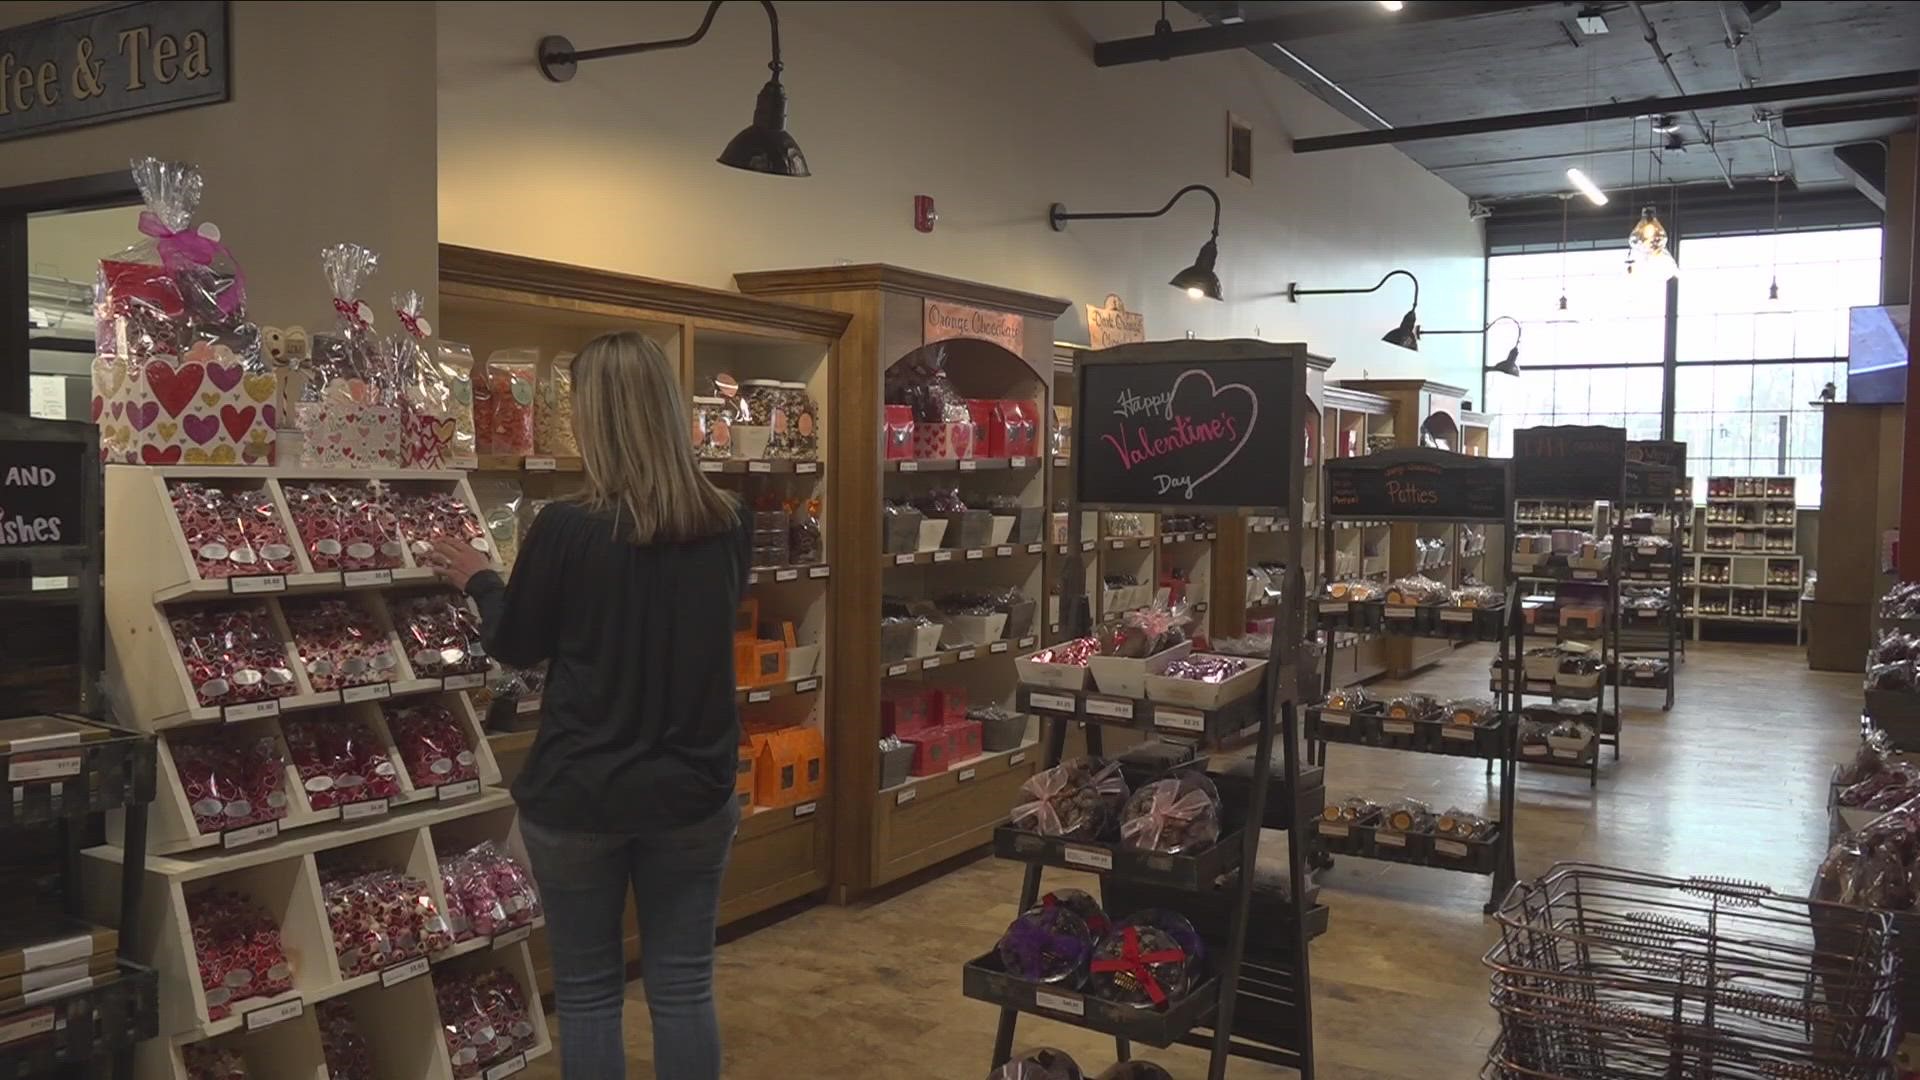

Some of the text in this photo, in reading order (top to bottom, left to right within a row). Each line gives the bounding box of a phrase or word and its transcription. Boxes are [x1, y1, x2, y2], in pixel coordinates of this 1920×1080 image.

[72, 36, 106, 99] &
[119, 26, 211, 91] Tea
[929, 304, 968, 336] Orange
[1113, 388, 1173, 421] Happy
[1101, 411, 1236, 470] Valentine's
[5, 465, 56, 487] AND
[1153, 474, 1194, 499] Day
[1386, 480, 1439, 504] Patties
